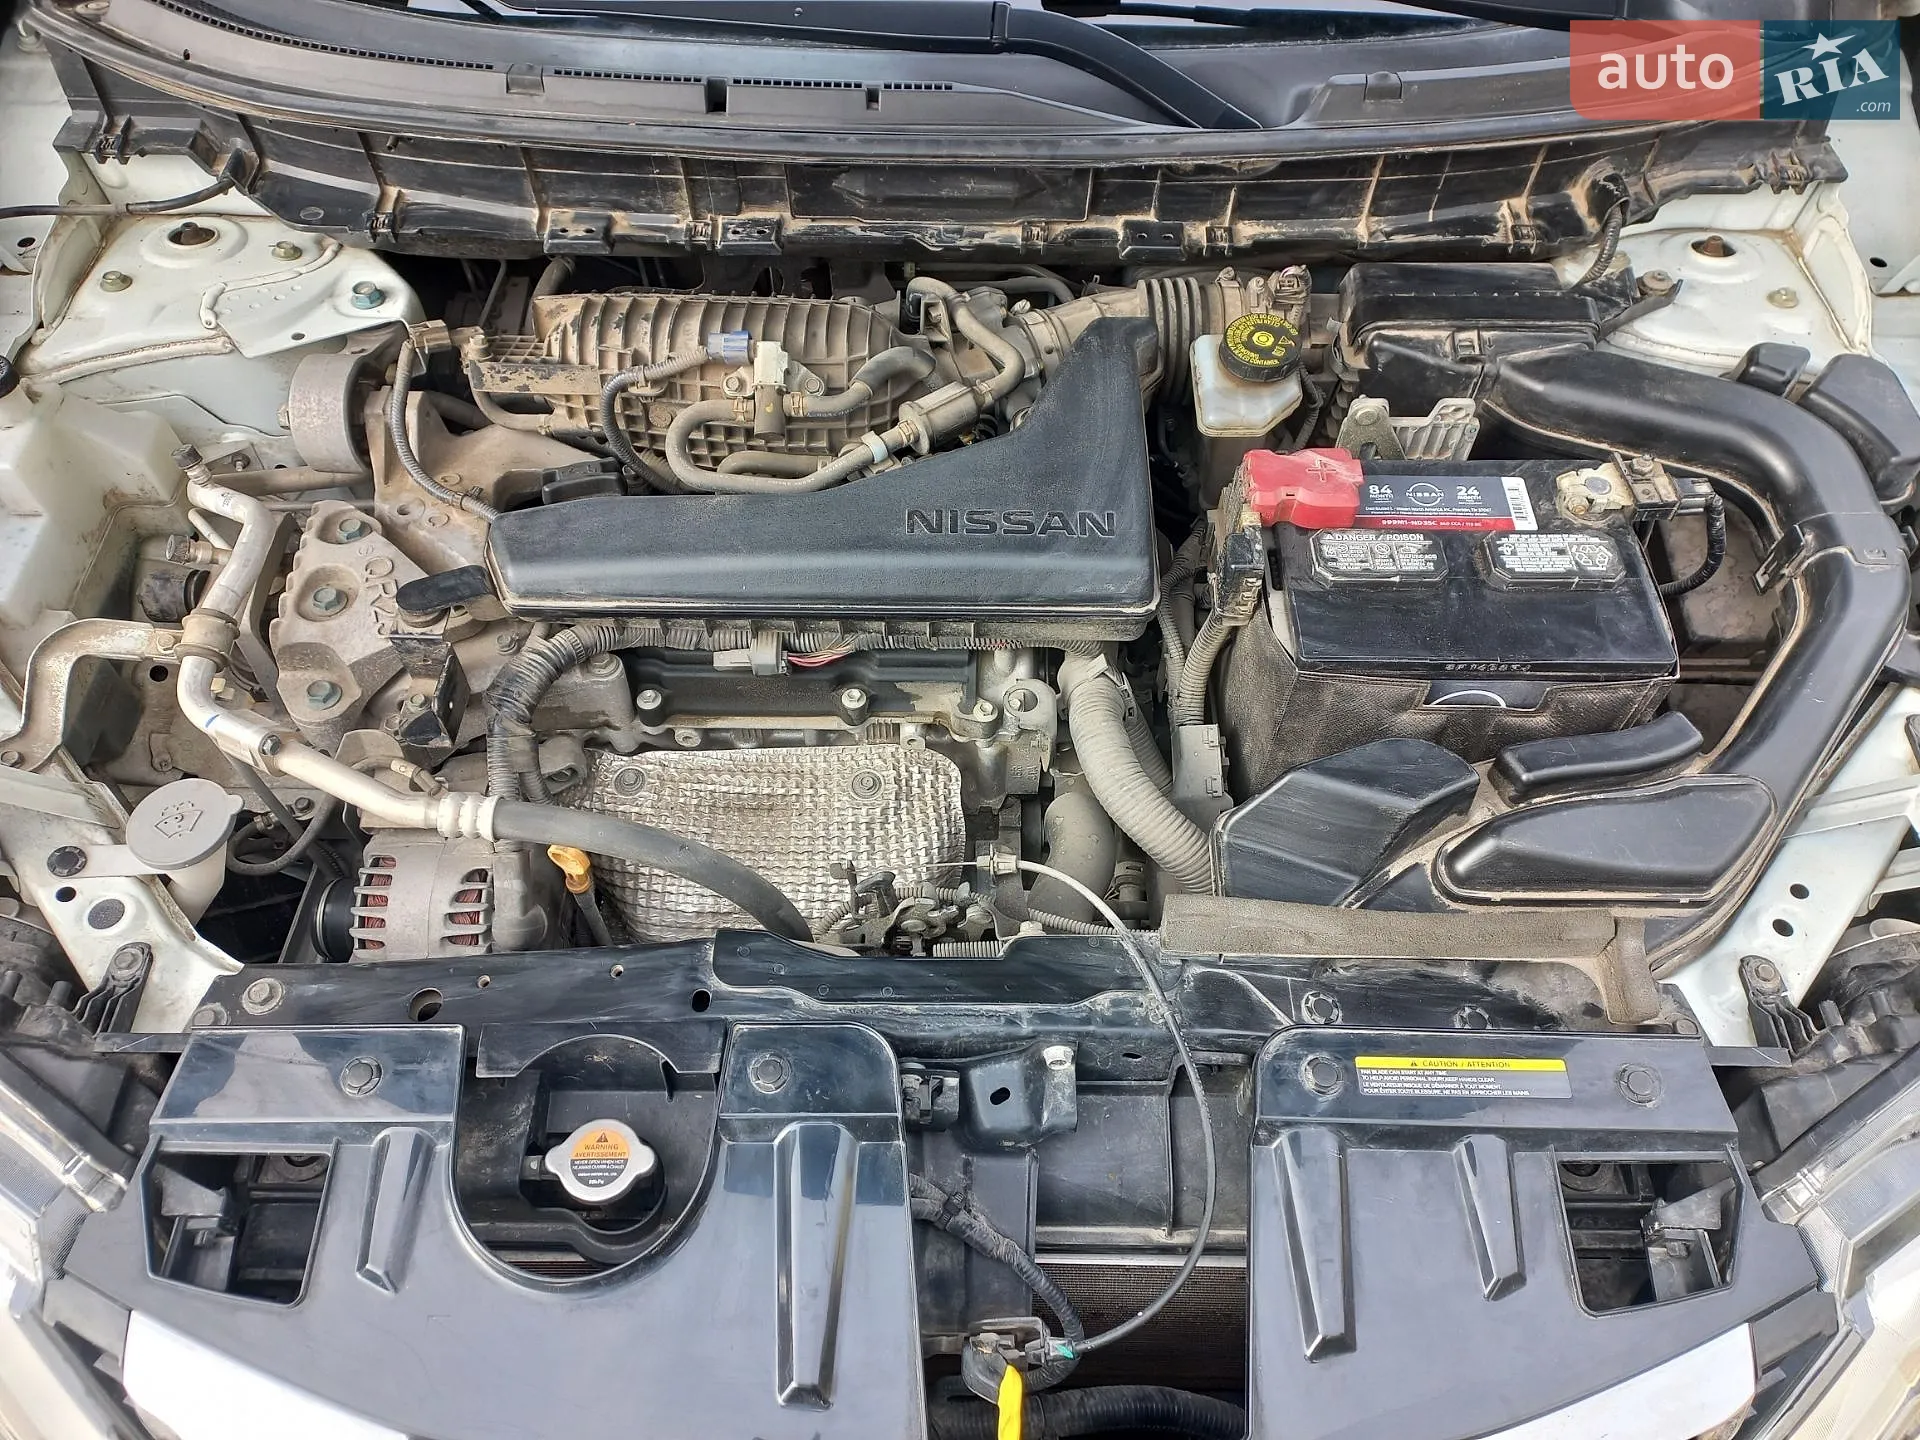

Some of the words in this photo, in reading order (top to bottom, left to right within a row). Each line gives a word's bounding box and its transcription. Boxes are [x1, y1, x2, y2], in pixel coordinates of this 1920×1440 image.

[1369, 484, 1392, 494] 84
[1456, 486, 1480, 496] 24
[905, 508, 1116, 537] NISSAN
